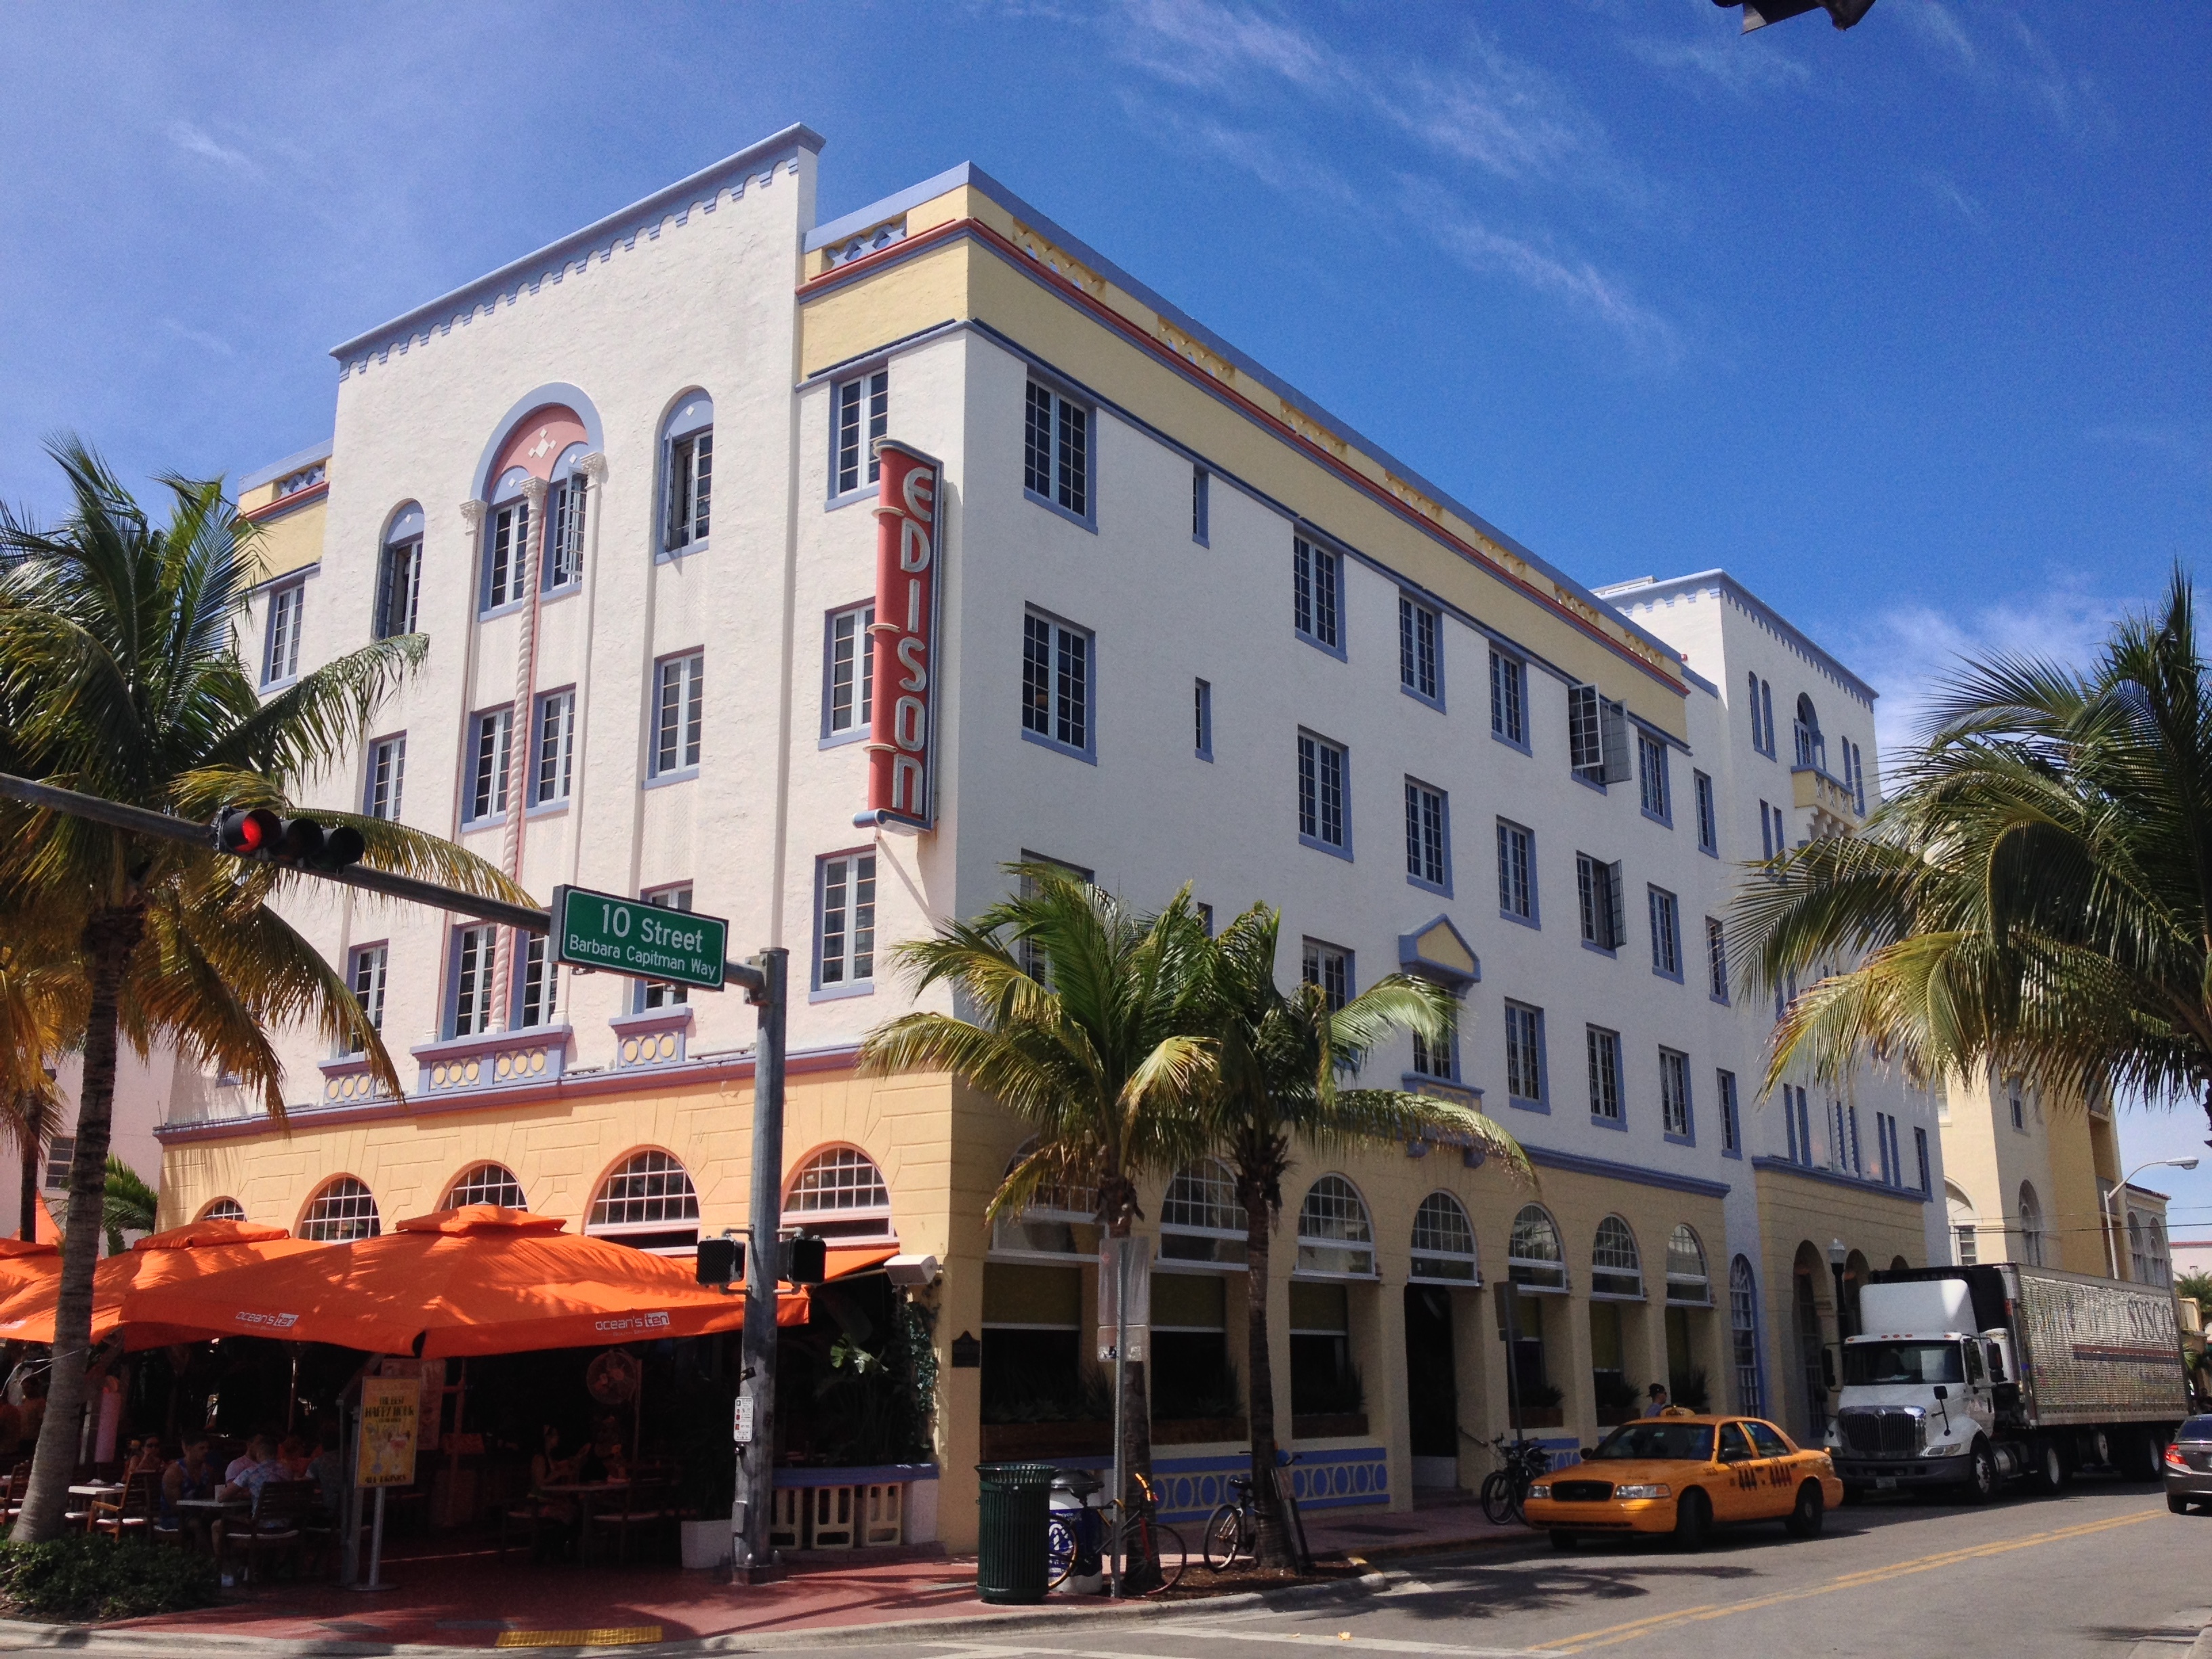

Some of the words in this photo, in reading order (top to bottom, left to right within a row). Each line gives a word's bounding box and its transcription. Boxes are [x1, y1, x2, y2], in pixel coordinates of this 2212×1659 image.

[602, 904, 630, 937] 10
[640, 918, 703, 953] Street
[569, 934, 620, 959] Barbara
[627, 945, 685, 971] Capitman
[691, 958, 716, 979] Way
[235, 1312, 275, 1324] ocean's
[274, 1313, 298, 1326] ten
[596, 1315, 643, 1330] ocean's
[644, 1313, 669, 1327] ten
[2127, 1296, 2174, 1340] SYSCO
[1738, 1468, 1757, 1491] 444
[1769, 1464, 1793, 1488] 4444
